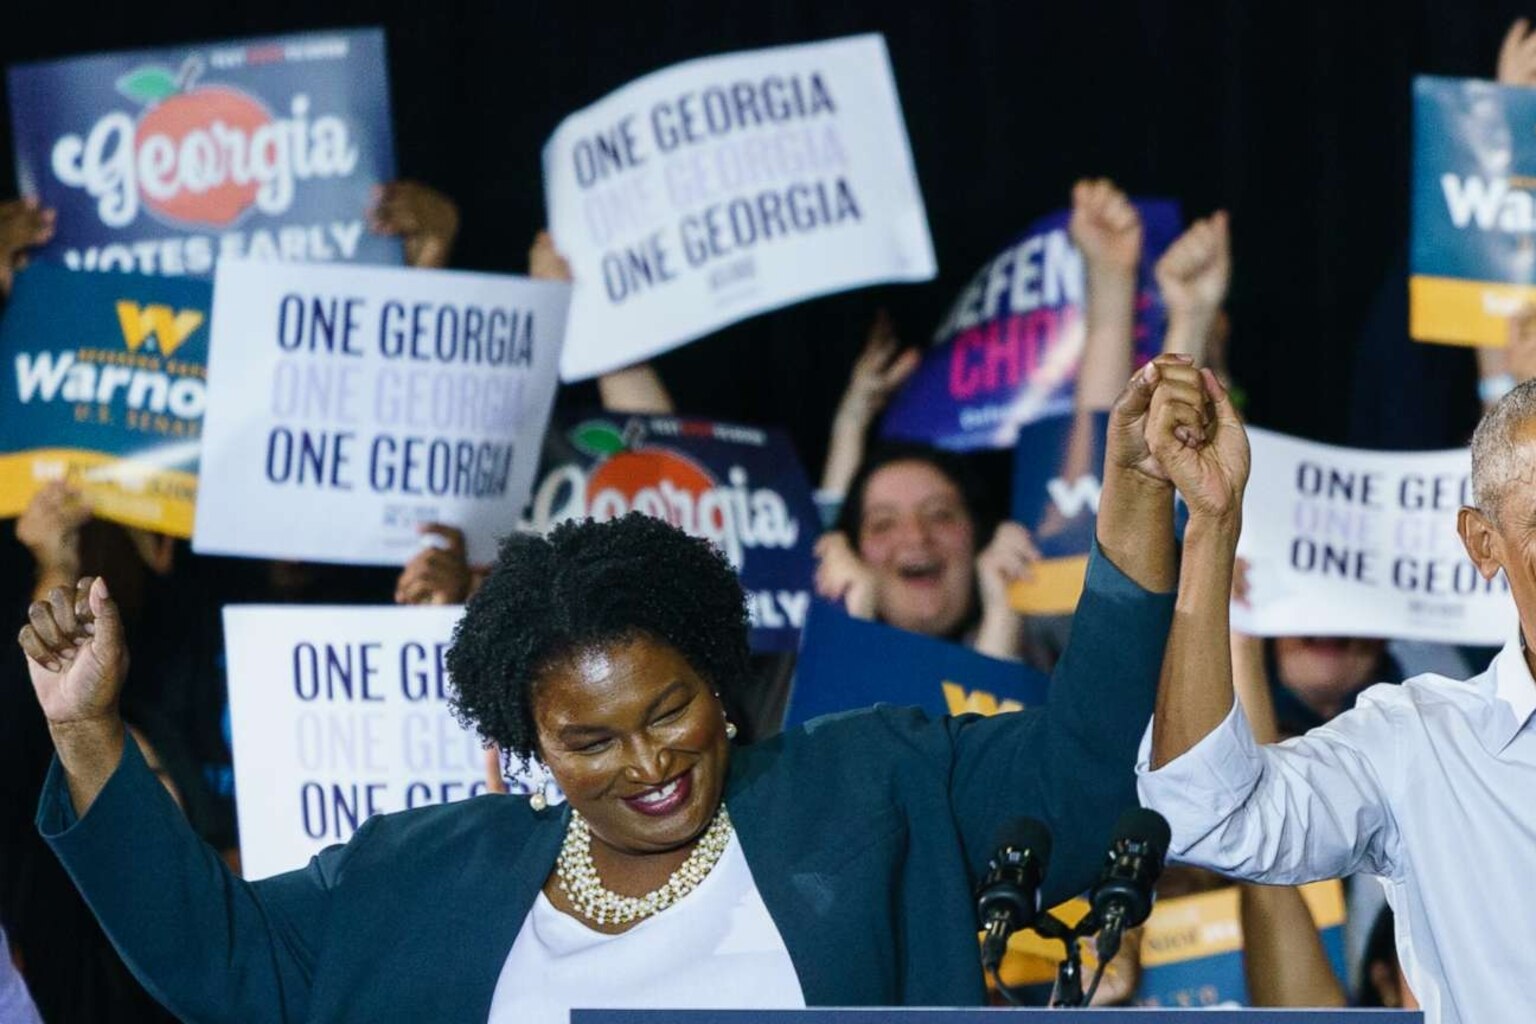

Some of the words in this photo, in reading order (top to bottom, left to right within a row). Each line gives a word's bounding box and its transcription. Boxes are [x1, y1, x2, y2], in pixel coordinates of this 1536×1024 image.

[51, 94, 360, 228] Georgia
[572, 112, 649, 190] ONE
[650, 70, 838, 156] GEORGIA
[601, 227, 677, 304] ONE
[679, 177, 864, 272] GEORGIA
[934, 228, 1085, 346] EFEN
[277, 293, 365, 357] ONE
[378, 298, 536, 368] GEORGIA
[265, 425, 356, 490] ONE
[1296, 460, 1380, 508] ONE
[1291, 536, 1376, 586] ONE
[293, 641, 386, 702] ONE
